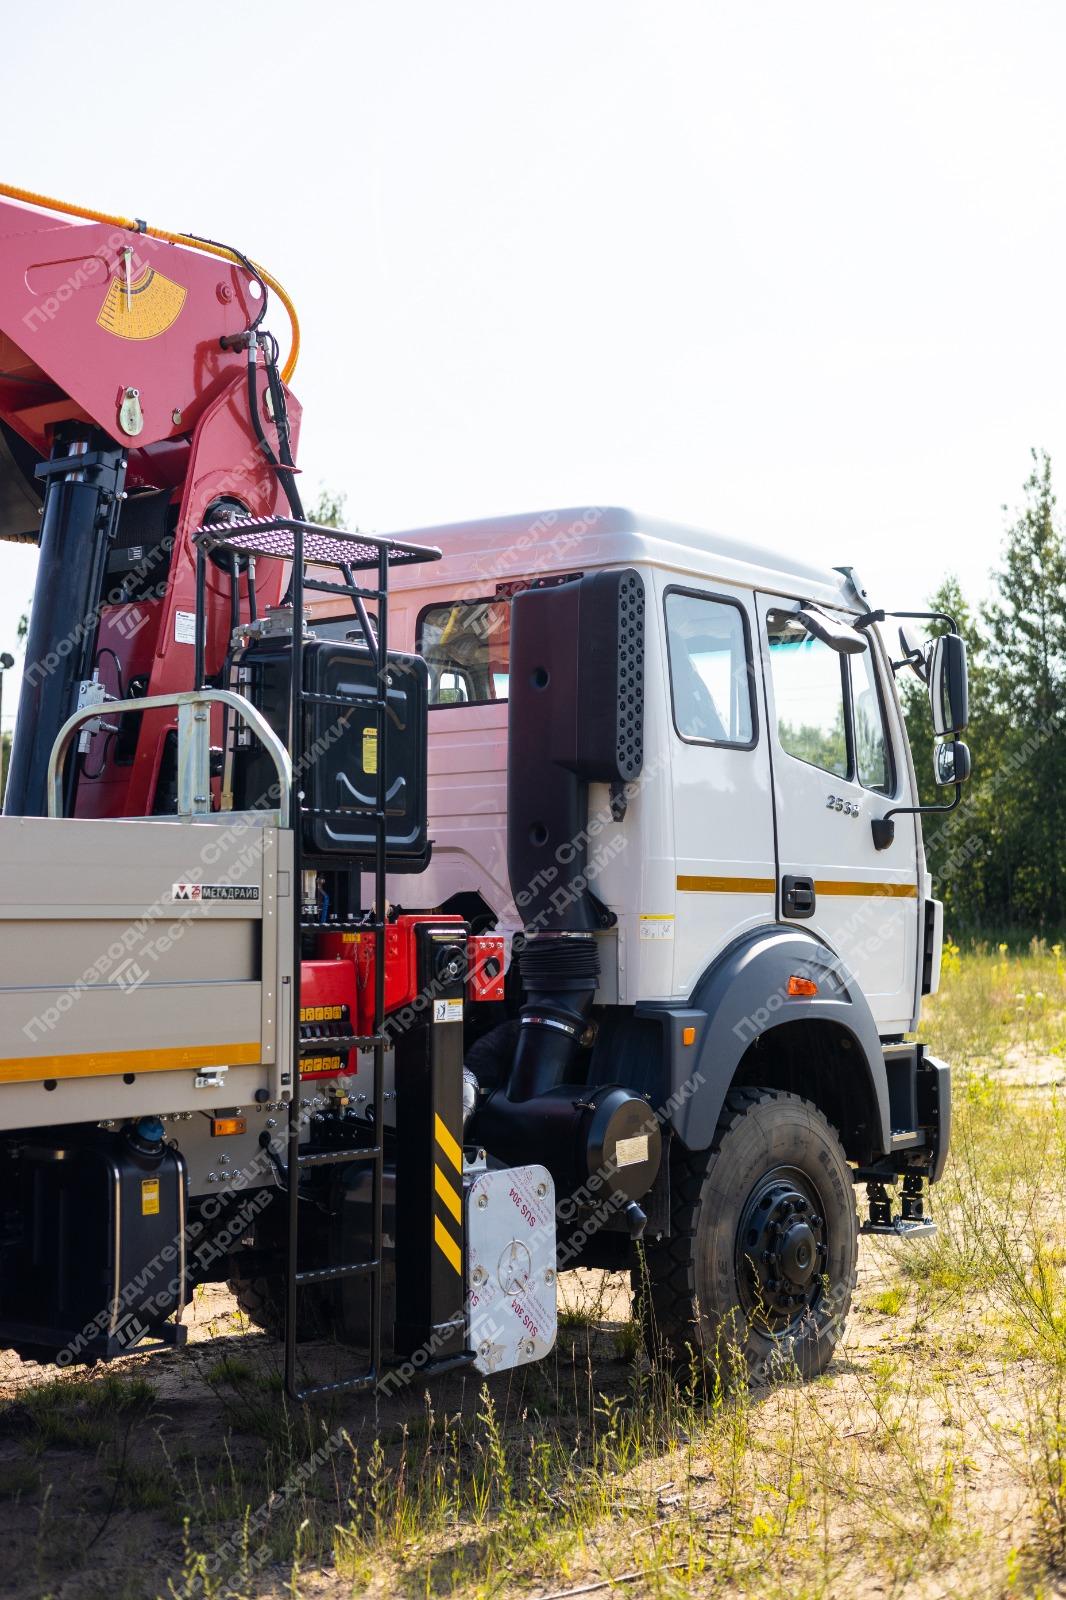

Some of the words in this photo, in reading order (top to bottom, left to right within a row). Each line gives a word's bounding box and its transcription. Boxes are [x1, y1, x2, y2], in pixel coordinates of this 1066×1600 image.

[202, 887, 258, 900] МЕГАДРАЙВ
[509, 1187, 522, 1207] 304
[520, 1204, 536, 1227] SUS
[511, 1299, 525, 1318] 304
[522, 1315, 538, 1337] SUS
